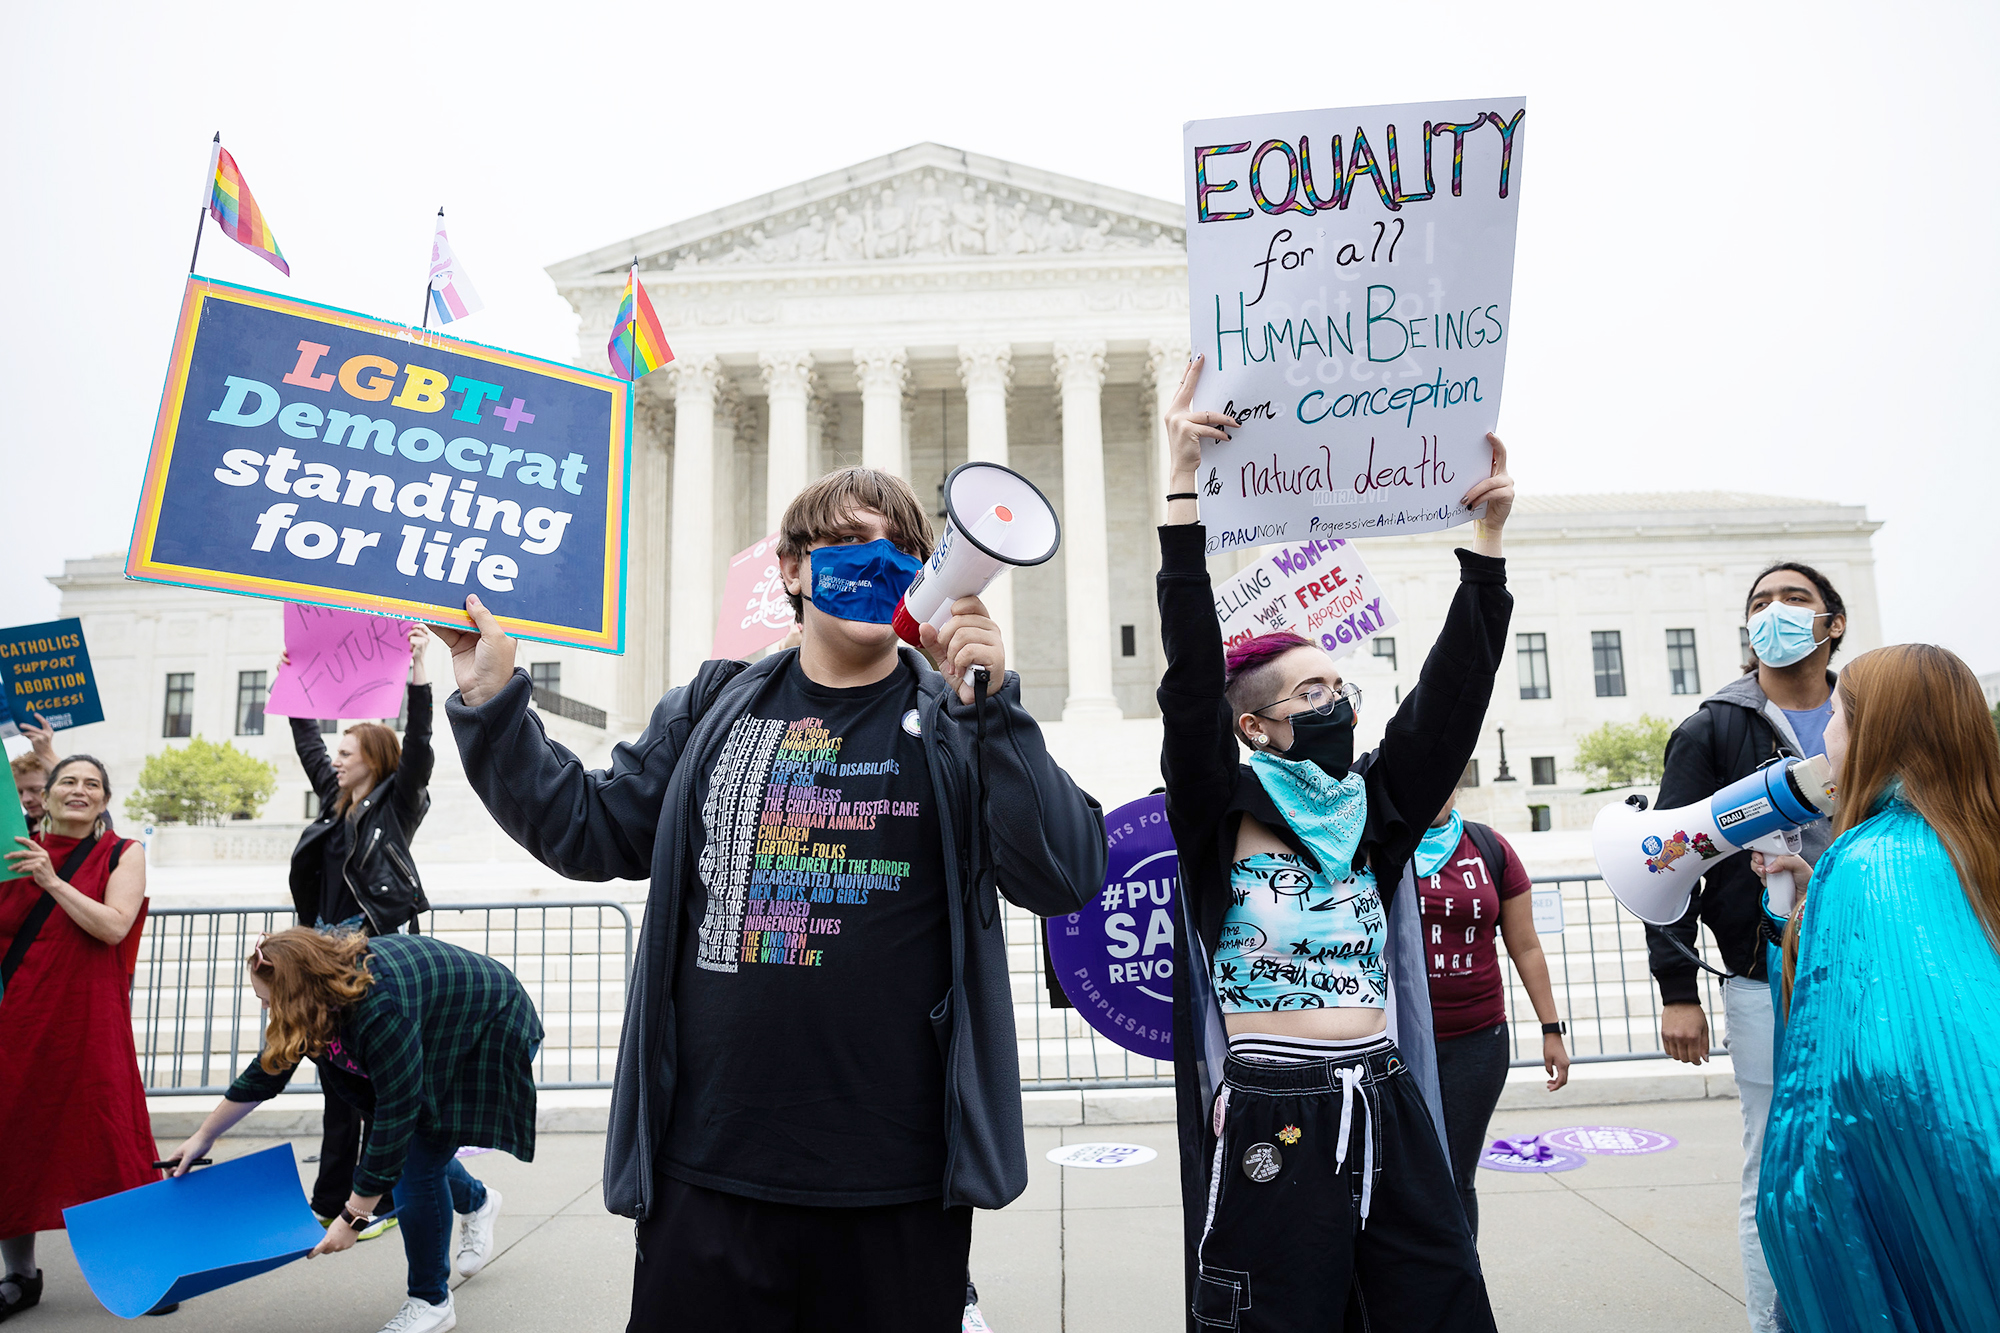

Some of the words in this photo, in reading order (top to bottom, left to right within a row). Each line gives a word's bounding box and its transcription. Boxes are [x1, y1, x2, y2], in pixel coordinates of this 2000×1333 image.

[1195, 109, 1525, 223] EQUALITY
[1246, 229, 1313, 306] for
[1337, 218, 1404, 266] all
[1216, 292, 1353, 371] HUMAN
[1367, 285, 1502, 363] BEINGS
[281, 340, 535, 433] LGBT+
[207, 375, 588, 495] Democrat
[1204, 468, 1224, 496] to
[1241, 445, 1333, 497] natural
[1354, 435, 1455, 494] death
[214, 446, 572, 555] standing
[251, 503, 381, 566] for
[396, 524, 519, 592] life
[1205, 522, 1288, 554] @PAAUNOW
[1214, 568, 1272, 623] ELLING
[1254, 594, 1287, 625] WON'T
[1294, 566, 1348, 609] FREE
[1270, 613, 1287, 630] BE
[1321, 597, 1385, 651] OGYNY
[1, 633, 81, 659] CATHOLICS
[13, 655, 77, 675] SUPPORT
[14, 672, 87, 695] ABORTION
[25, 692, 85, 713] ACCESS!
[761, 730, 783, 740] FOR:
[785, 730, 803, 741] THE
[804, 728, 830, 740] POOR
[764, 719, 787, 730] FOR:
[789, 717, 823, 731] WOMEN
[757, 739, 779, 750] FOR:
[780, 737, 843, 751] IMMIGRANTS
[752, 750, 775, 760] FOR:
[776, 750, 810, 762] BLACK
[811, 748, 838, 763] LIVES
[748, 760, 771, 771] FOR:
[772, 760, 811, 775] PEOPLE
[813, 760, 837, 776] WITH
[839, 759, 899, 777] DISABILITIES
[744, 771, 768, 784] FOR:
[770, 771, 788, 785] THE
[791, 773, 815, 787] SICK
[740, 784, 765, 797] FOR:
[766, 784, 787, 798] THE
[788, 785, 842, 802] HOMELESS
[738, 797, 761, 811] FOR:
[764, 797, 784, 812] THE
[786, 798, 837, 816] CHILDREN
[839, 802, 851, 816] IN
[853, 799, 890, 816] FOSTER
[892, 801, 919, 817] CARE
[735, 811, 758, 826] FOR:
[760, 811, 826, 829] NON-HUMAN
[827, 815, 876, 830] ANIMALS
[1721, 811, 1743, 827] PAAU
[732, 825, 756, 840] FOR:
[758, 826, 810, 842] CHILDREN
[731, 840, 754, 855] FOR:
[756, 840, 809, 856] LGBTQIA+
[812, 843, 846, 859] FOLKS
[730, 855, 752, 870] FOR:
[755, 855, 772, 869] THE
[776, 856, 828, 873] CHILDREN
[830, 859, 846, 874] AT
[848, 859, 868, 874] THE
[870, 859, 910, 877] BORDER
[729, 869, 750, 885] FOR:
[752, 869, 830, 888] INCARCERATED
[832, 874, 901, 891] INDIVIDUALS
[1066, 912, 1080, 936] EQ
[1107, 823, 1134, 848] HTS
[726, 885, 747, 900] FOR:
[810, 887, 834, 903] AND
[836, 888, 869, 904] GIRLS
[725, 900, 745, 915] FOR:
[747, 900, 766, 915] THE
[767, 900, 811, 917] ABUSED
[726, 916, 742, 930] FOR:
[744, 915, 808, 933] INDIGENOUS
[809, 918, 841, 935] LIVES
[1104, 908, 1174, 959] SA
[723, 931, 740, 946] FOR:
[743, 931, 761, 946] THE
[762, 931, 807, 949] UNBORN
[721, 946, 738, 961] FOR:
[741, 947, 759, 962] THE
[761, 947, 796, 965] WHOLE
[798, 949, 823, 966] LIFE
[1108, 958, 1173, 984] REVO
[1074, 967, 1171, 1043] PURPLESASH
